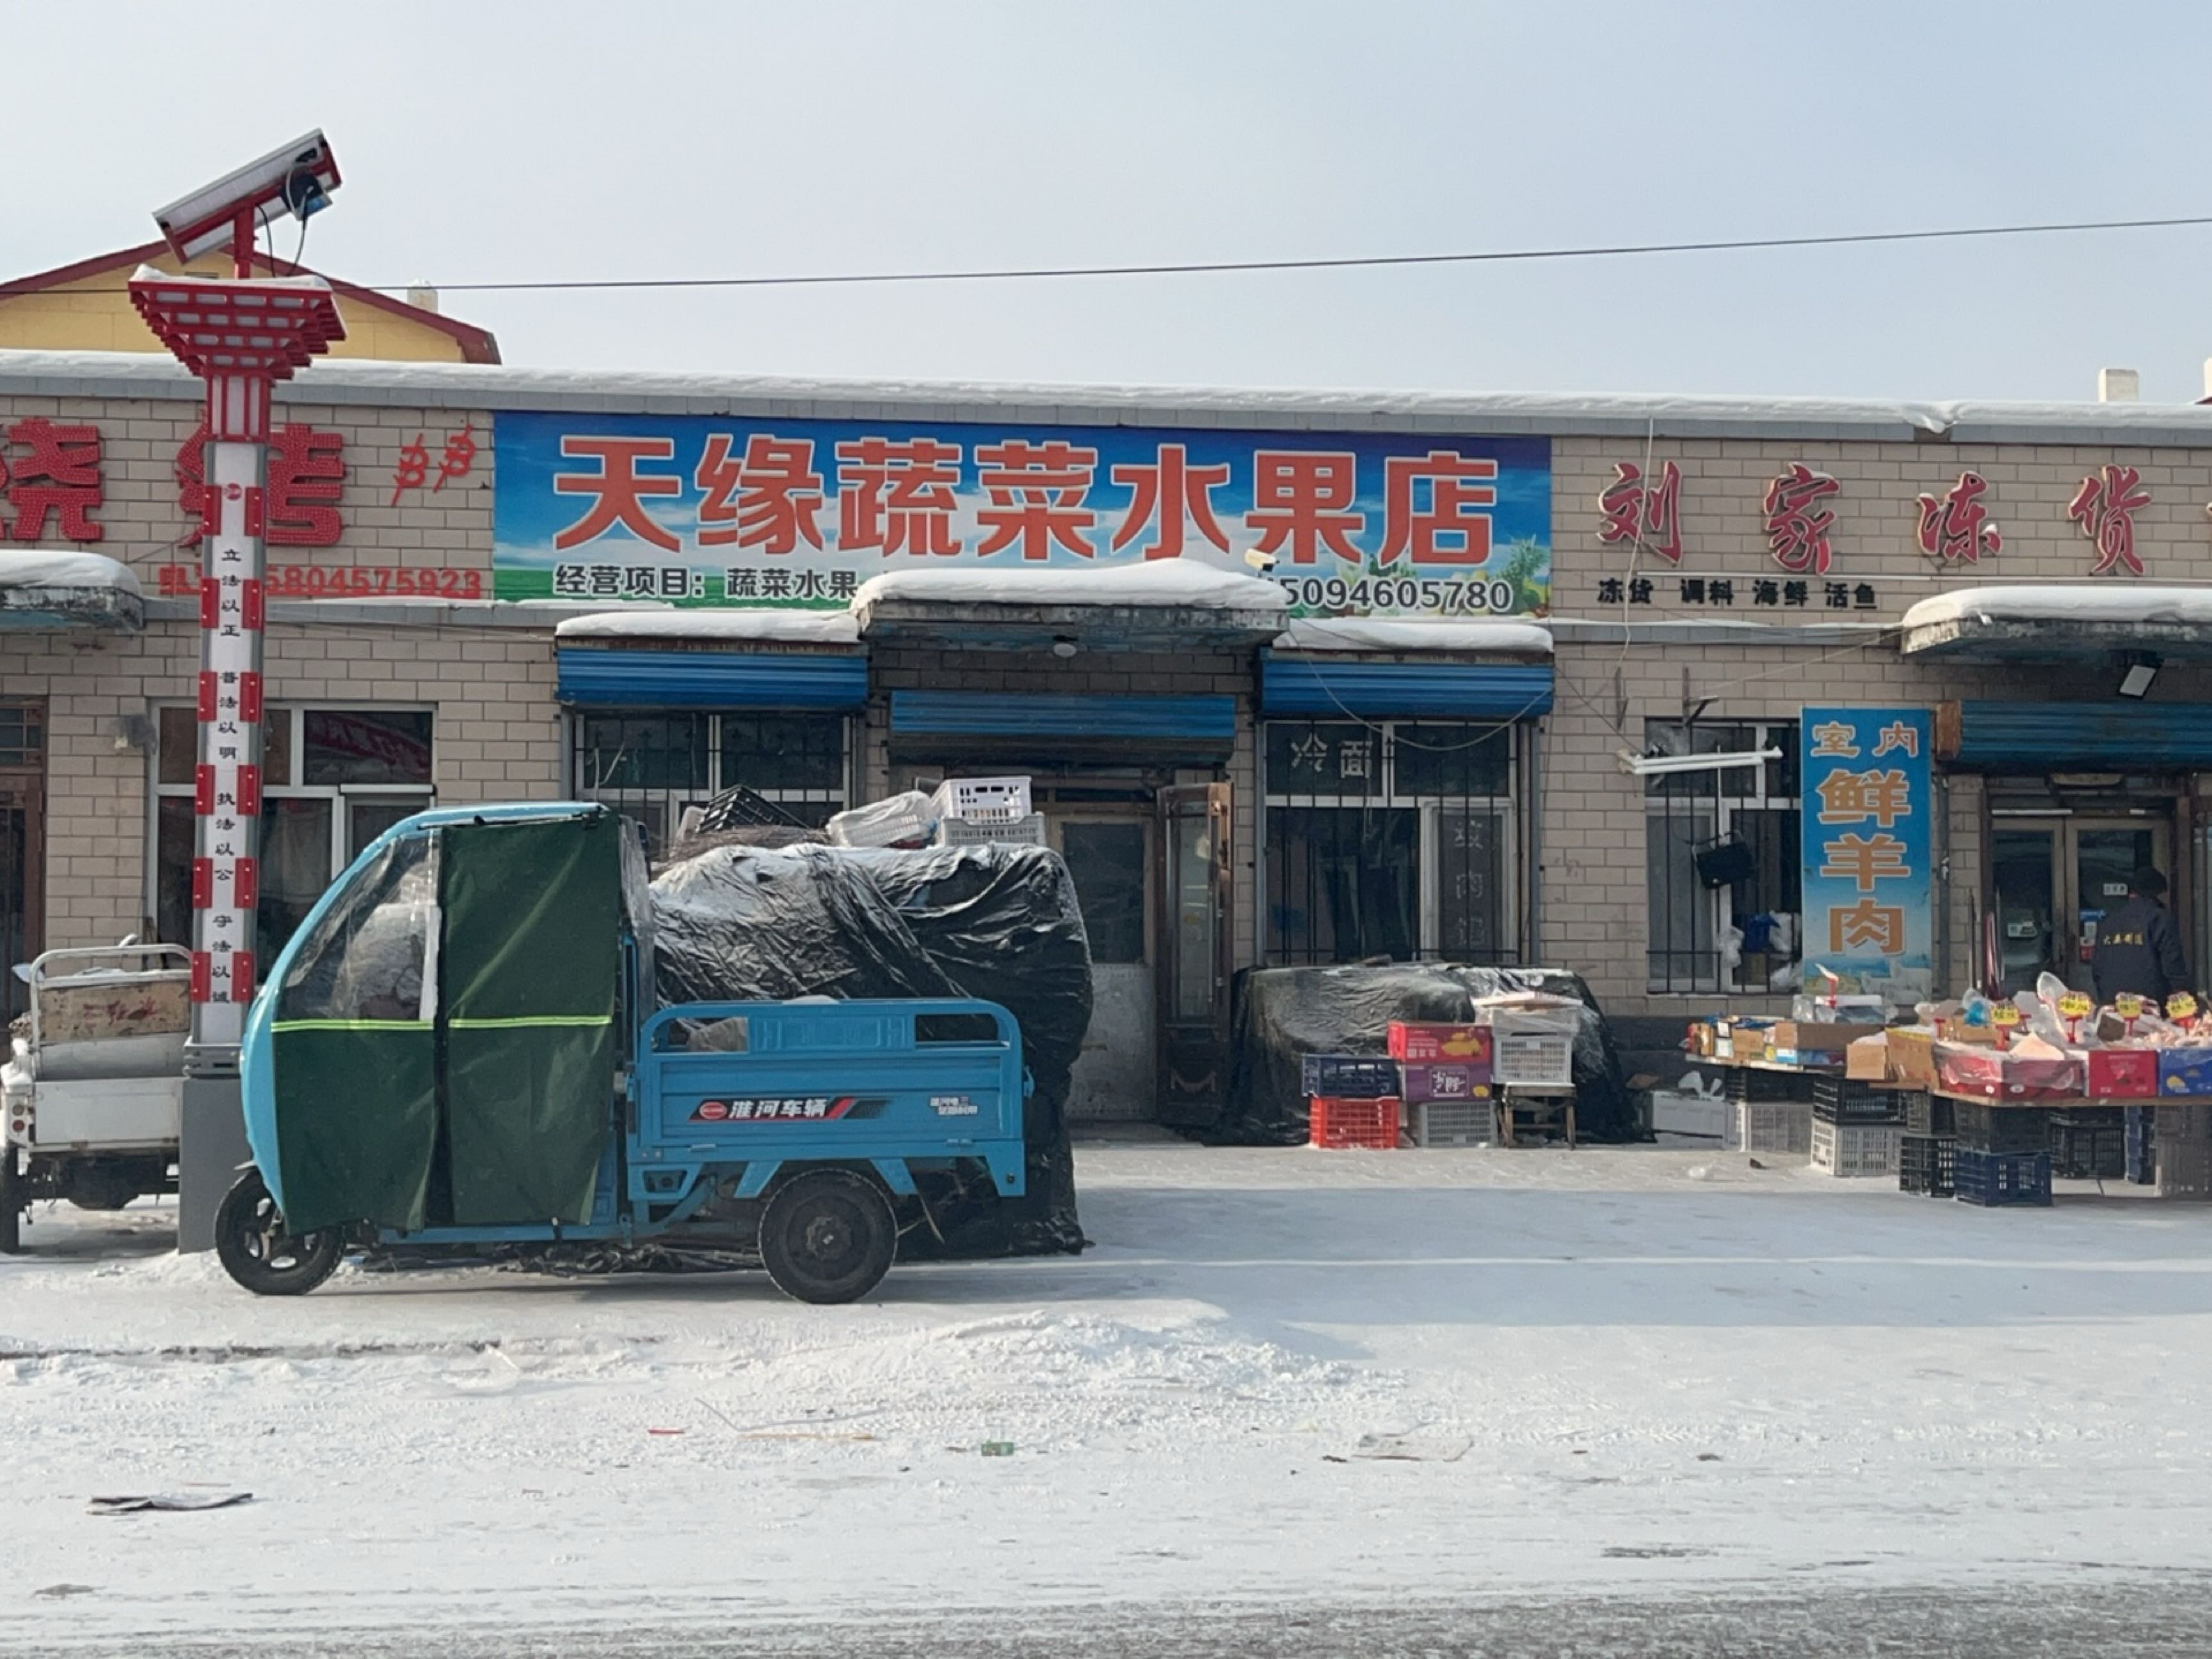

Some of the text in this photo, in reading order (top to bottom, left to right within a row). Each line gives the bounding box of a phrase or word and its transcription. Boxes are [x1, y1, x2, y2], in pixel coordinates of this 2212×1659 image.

[554, 434, 1498, 566] 天缘蔬菜水果店
[1596, 461, 2152, 576] 刘家冻货
[220, 549, 243, 637] 立法以正
[266, 563, 482, 600] 5804575923
[1267, 577, 1512, 609] 5094605780
[1598, 577, 1877, 609] 冻货 调料 海鲜 活鱼
[1290, 732, 1373, 779] 冷面
[1811, 721, 1919, 757] 室内
[214, 792, 237, 882] 执法以公
[1816, 768, 1912, 956] 鲜羊肉
